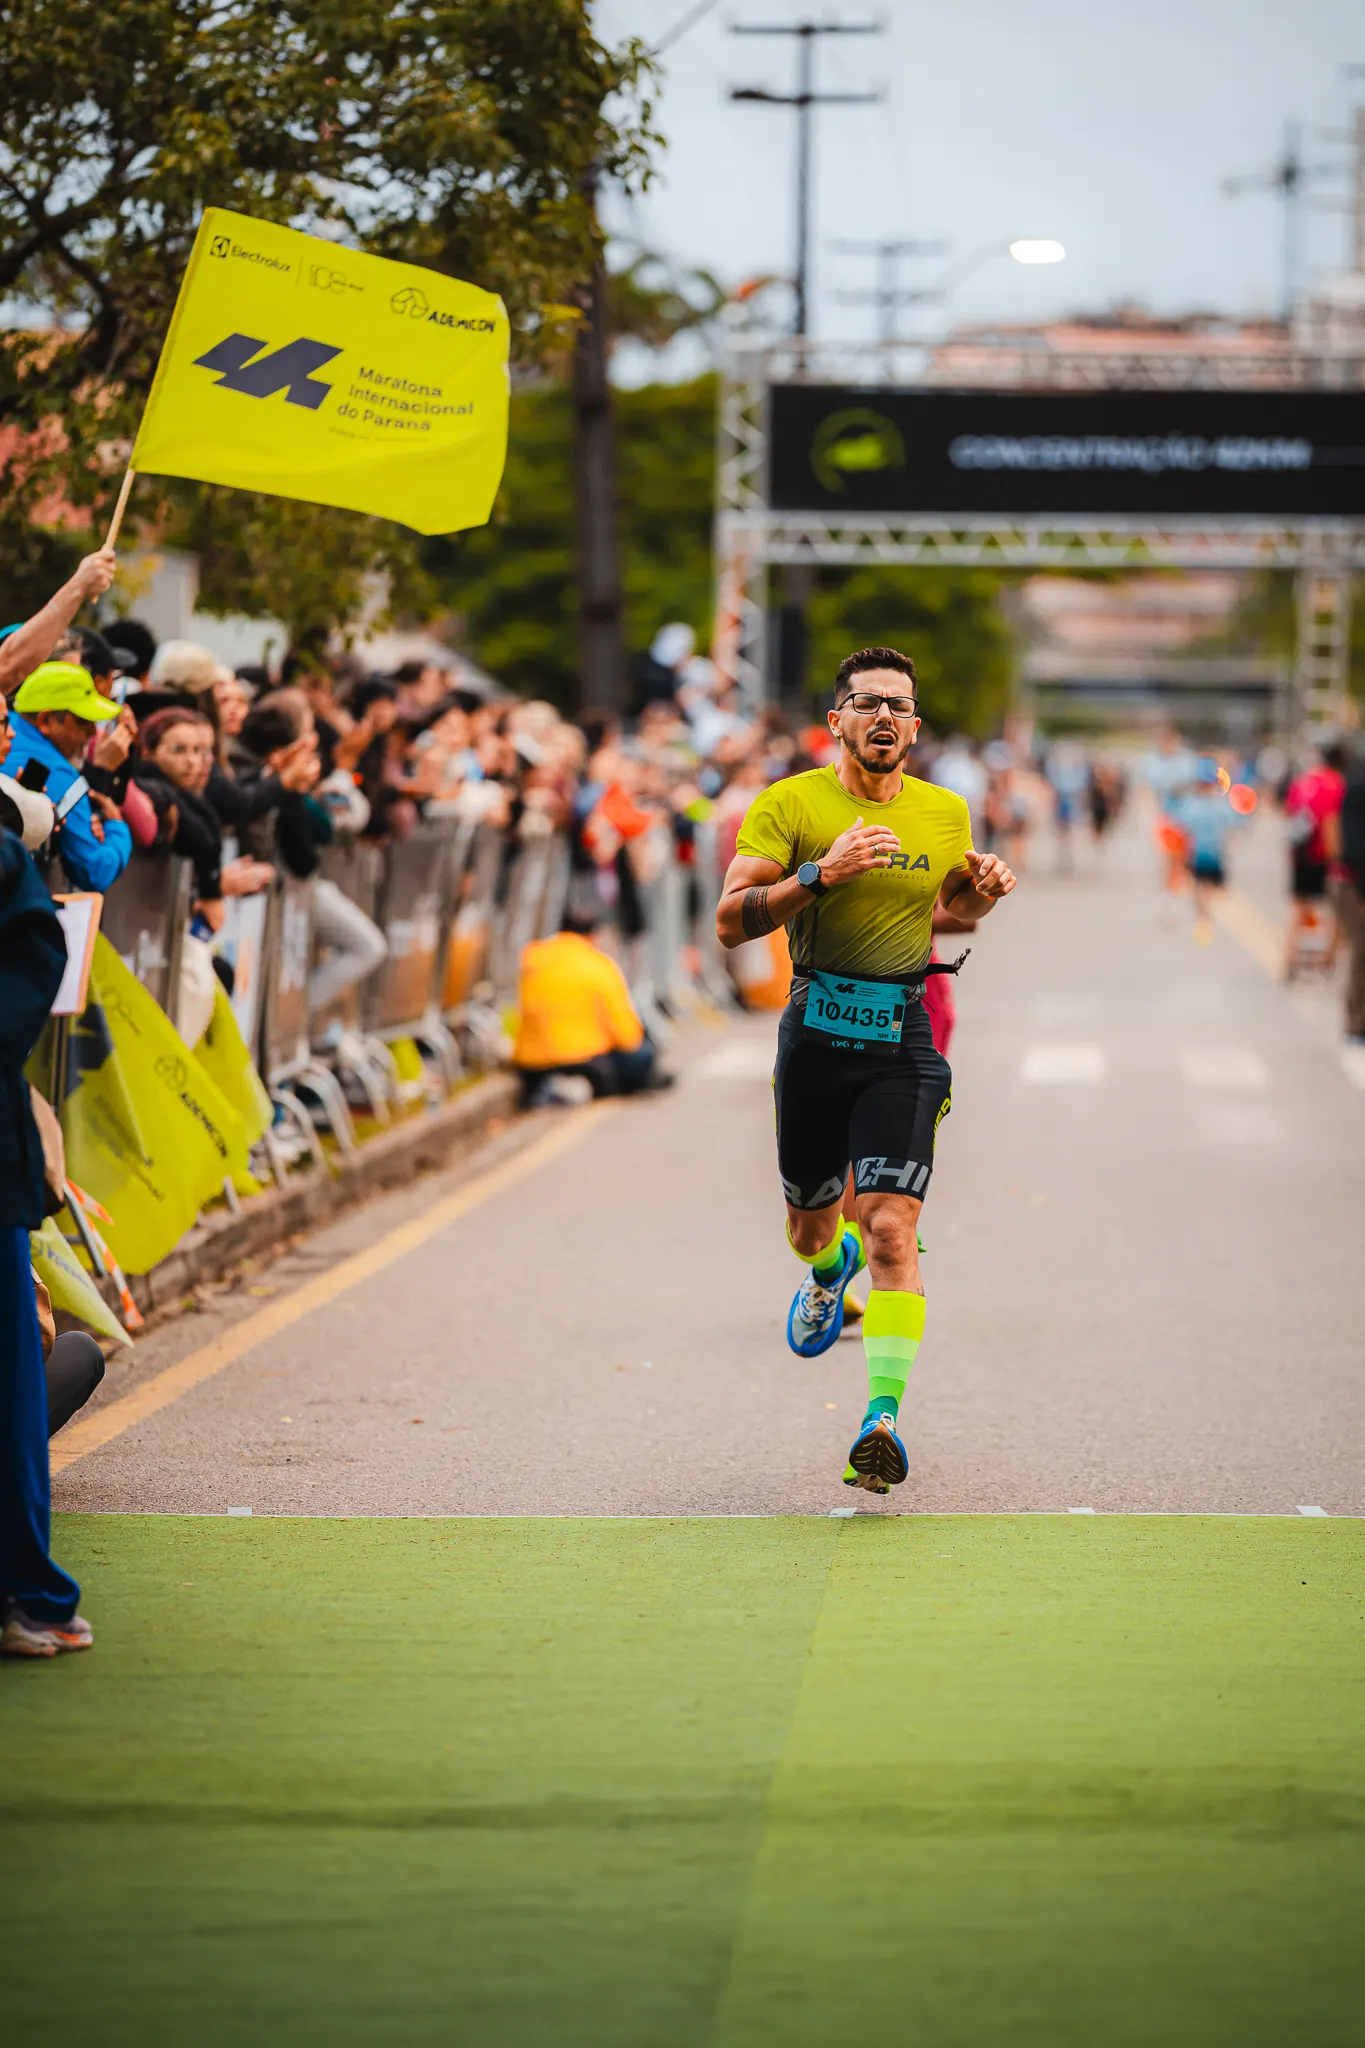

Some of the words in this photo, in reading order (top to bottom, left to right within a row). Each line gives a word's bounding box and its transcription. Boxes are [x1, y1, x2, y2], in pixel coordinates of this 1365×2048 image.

[232, 245, 291, 272] Electrolux
[428, 311, 496, 333] ADEMICON
[358, 366, 443, 397] Maratona
[349, 385, 474, 416] Internacional
[337, 403, 359, 419] do
[362, 409, 431, 431] Paraná
[879, 871, 930, 881] ESPORTIVA
[815, 998, 890, 1028] 10435
